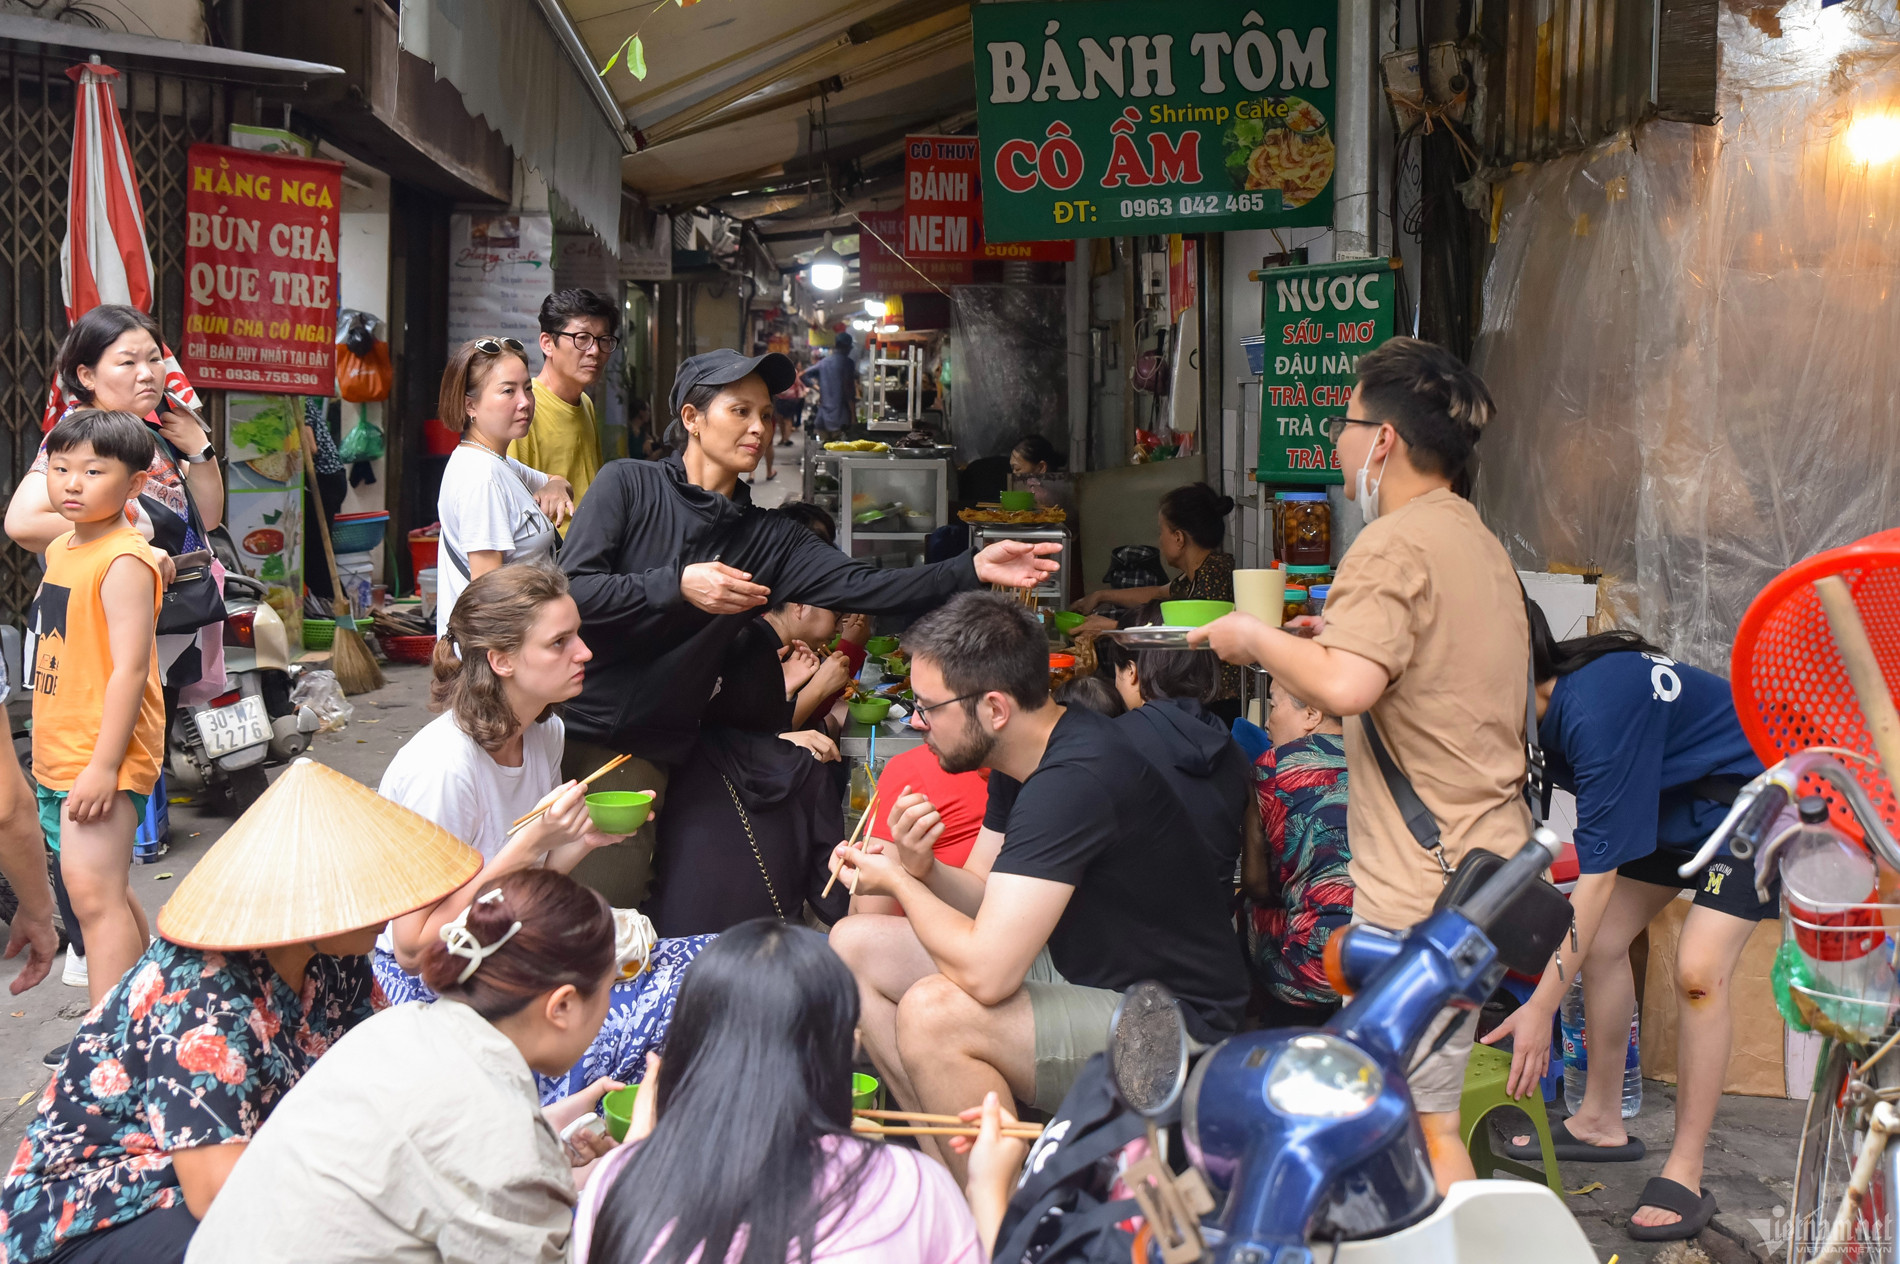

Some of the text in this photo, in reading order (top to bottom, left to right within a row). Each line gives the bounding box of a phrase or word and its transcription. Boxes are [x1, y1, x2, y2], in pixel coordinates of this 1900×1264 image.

[986, 9, 1330, 104] BÁNH TÔM
[1149, 99, 1289, 125] Shrimp Cake
[910, 139, 933, 159] CÔ
[994, 106, 1203, 193] CÔ ẦM
[193, 156, 334, 210] HẰNG NGA
[909, 166, 968, 202] BÁNH
[1052, 193, 1265, 224] ĐT: 0963 042 465
[187, 205, 336, 263] BÚN CHẢ
[908, 215, 968, 253] NEM
[189, 262, 331, 309] QUE TRE
[186, 312, 229, 335] (BÚN
[269, 318, 292, 340] CÔ
[294, 323, 332, 345] NGA)
[1282, 318, 1322, 345] SẤU
[1337, 320, 1375, 344] MƠ
[209, 343, 234, 361] BÁN
[236, 347, 258, 363] DUY
[260, 344, 287, 364] NHẤT
[290, 350, 307, 368] TẠI
[1274, 353, 1317, 380] ĐẬU
[225, 368, 318, 385] 0936.759.390
[1268, 382, 1309, 407] TRÀ
[1277, 413, 1314, 437] TRÀ
[1286, 444, 1327, 470] TRÀ
[206, 702, 257, 732] 30-M2
[215, 722, 263, 751] 4276
[1703, 871, 1725, 895] M
